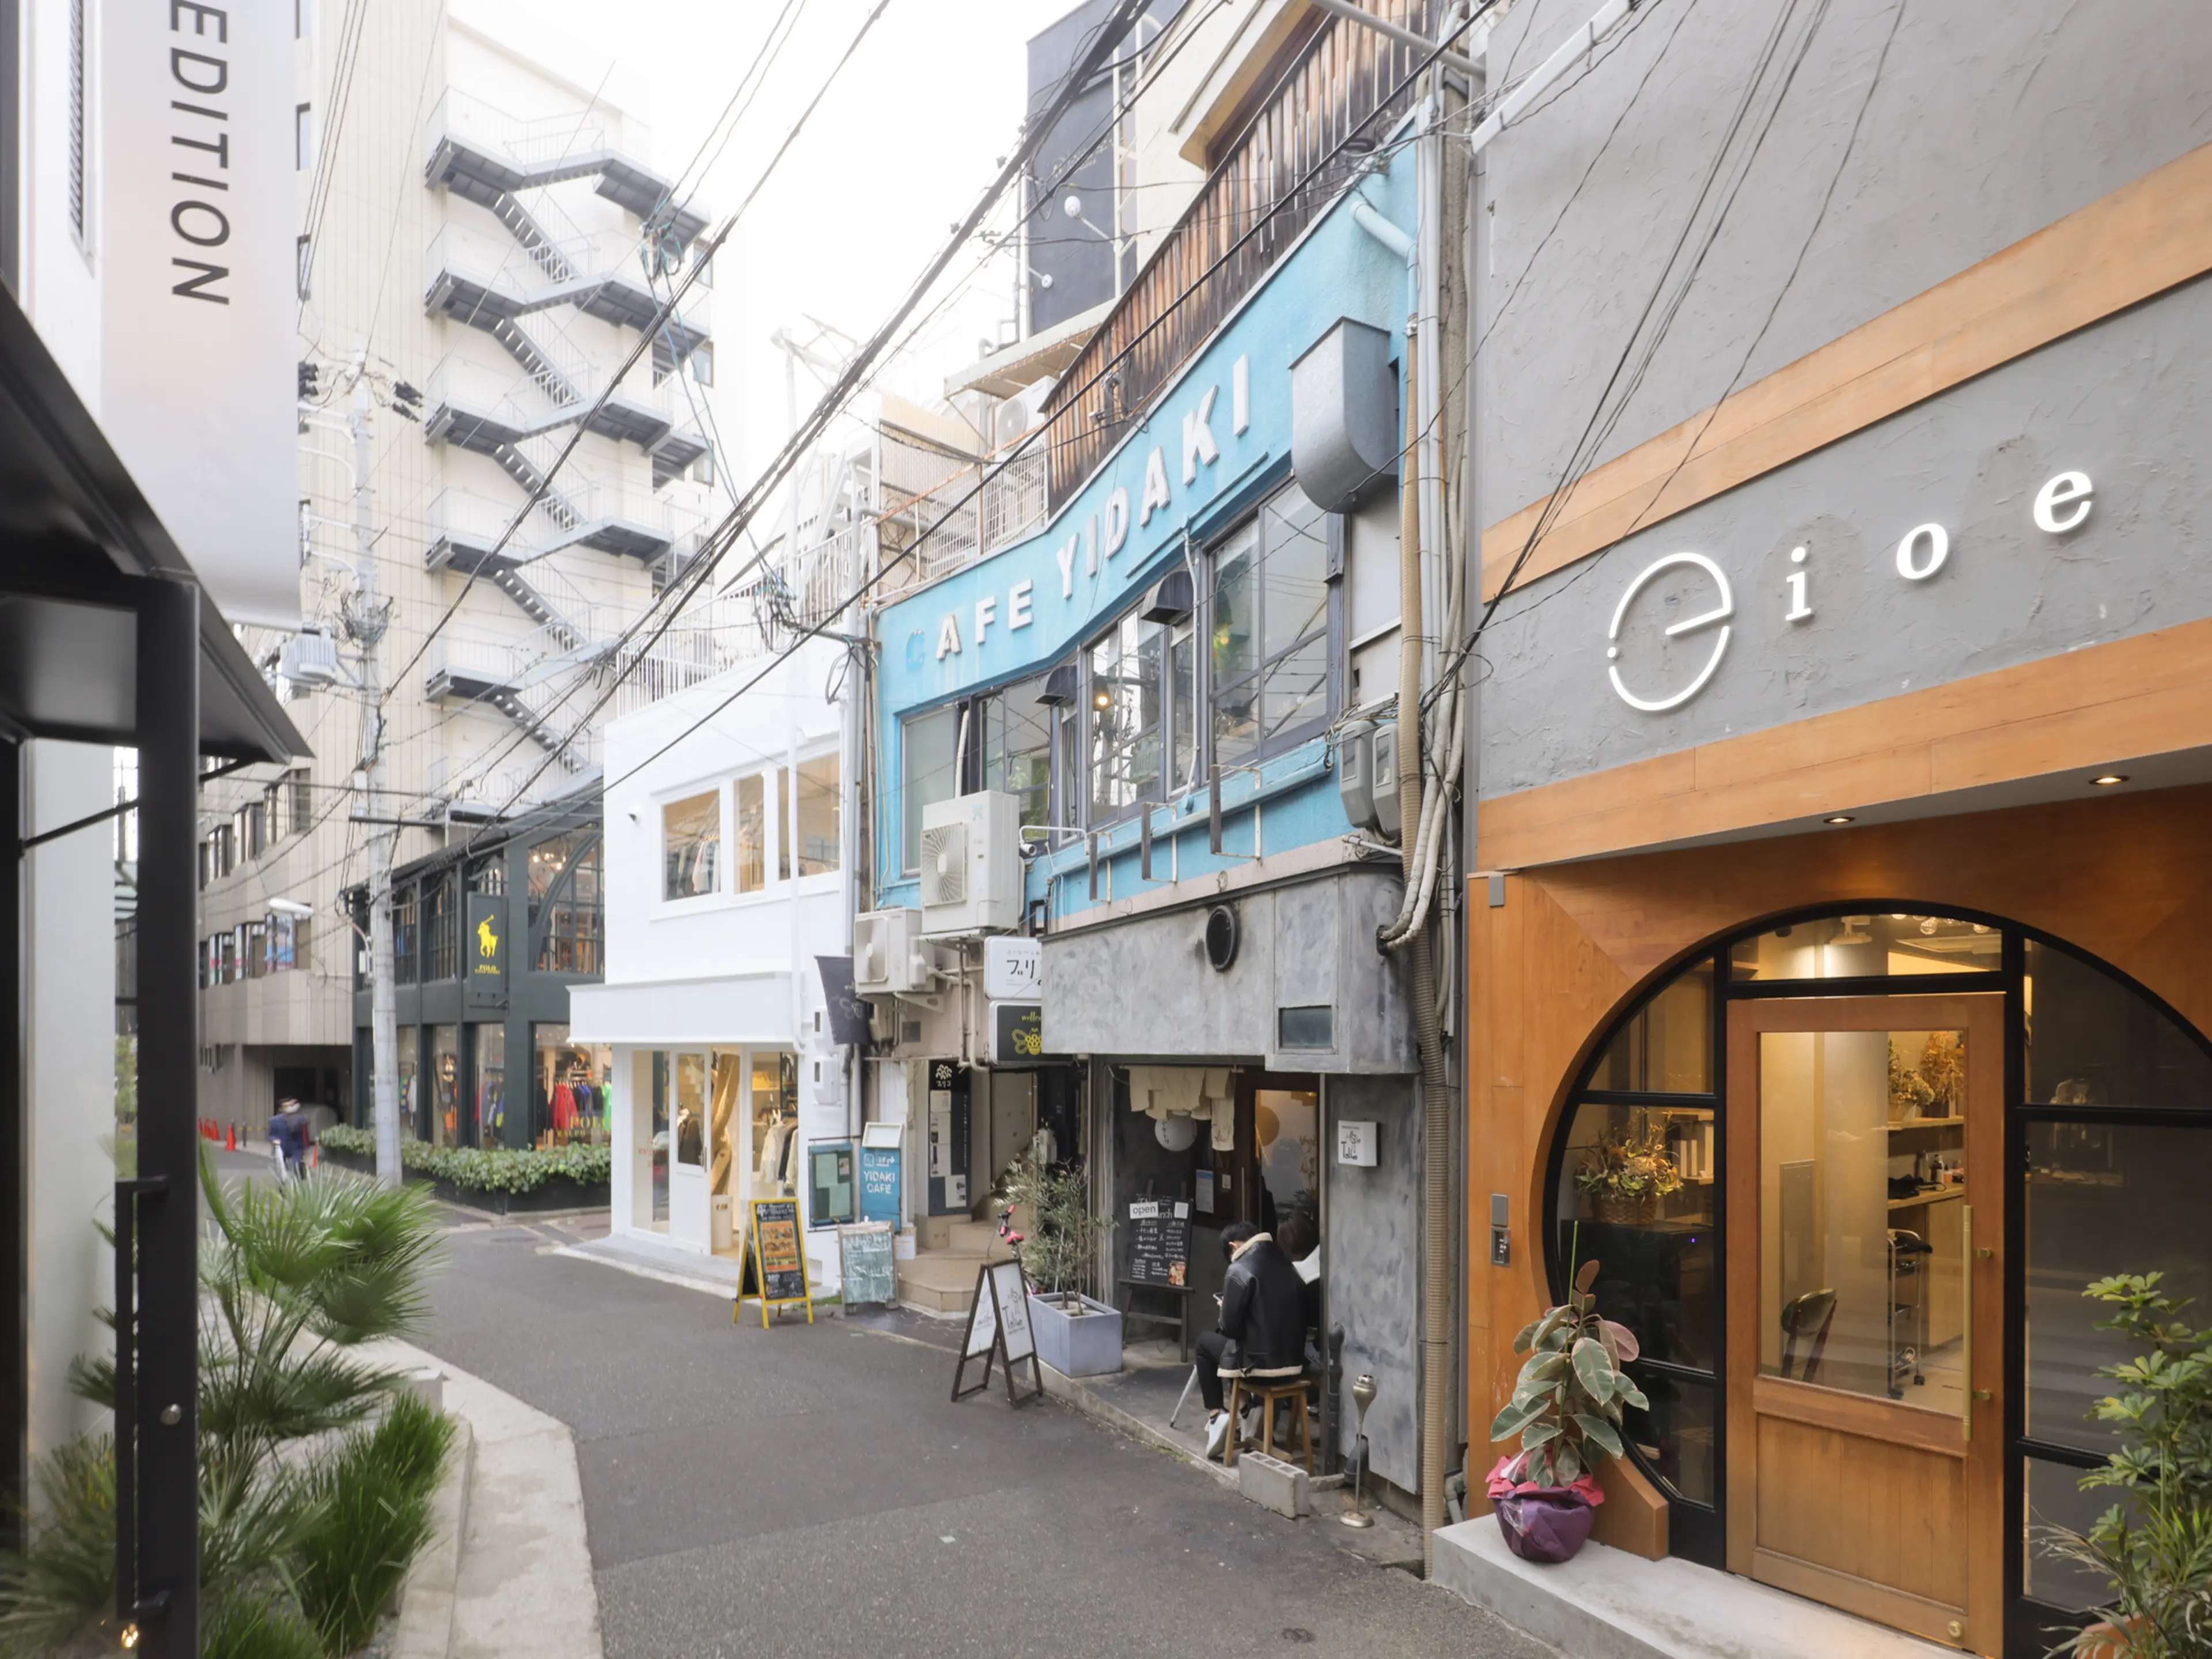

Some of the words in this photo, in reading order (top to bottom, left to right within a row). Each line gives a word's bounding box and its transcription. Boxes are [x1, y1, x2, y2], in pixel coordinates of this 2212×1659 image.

[170, 0, 230, 305] EDITION
[906, 578, 1034, 671] CAFE
[1056, 354, 1250, 600] YIDAKI
[1006, 959, 1041, 986] ブリ
[863, 1171, 896, 1182] YIDAKI
[866, 1183, 892, 1194] CAFE
[1132, 1206, 1157, 1216] open
